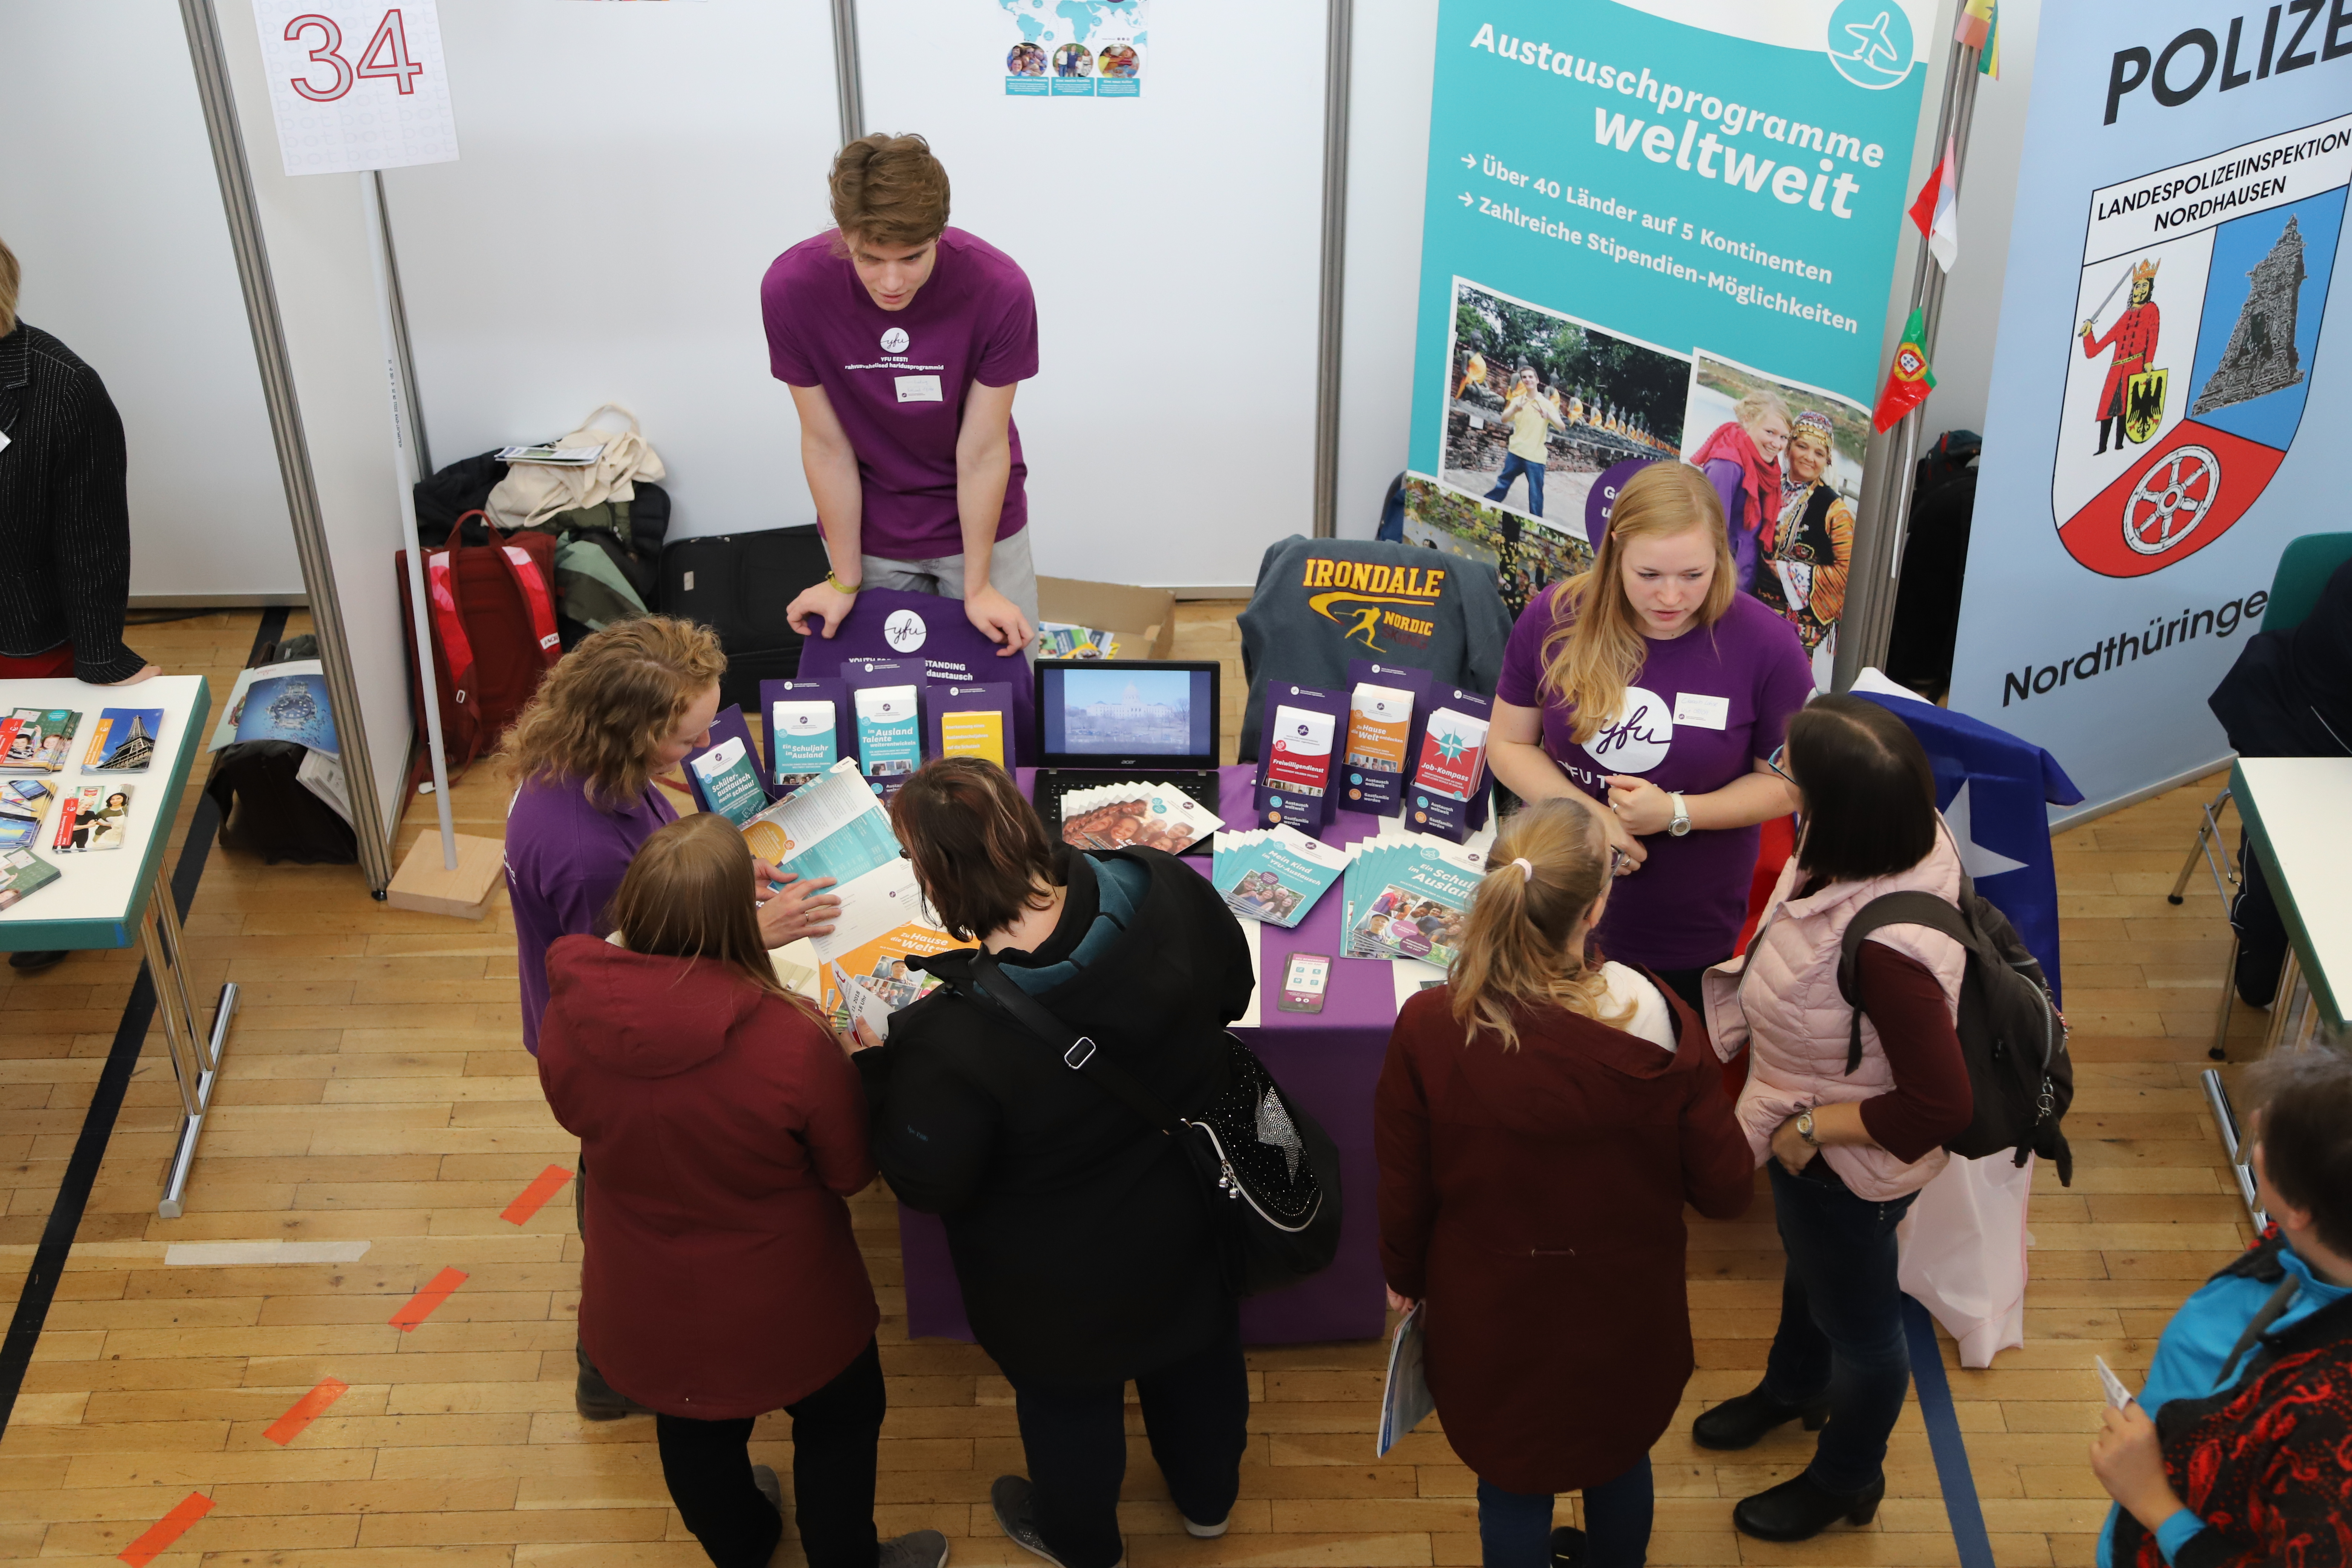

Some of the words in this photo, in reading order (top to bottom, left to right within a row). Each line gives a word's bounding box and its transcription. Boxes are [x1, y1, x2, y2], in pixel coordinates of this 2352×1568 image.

[284, 9, 423, 102] 34
[2104, 0, 2352, 126] POLIZE
[1470, 23, 1885, 168] Austauschprogramme
[1594, 106, 1860, 220] weltweit
[2098, 129, 2352, 221] LANDESPOLIZEIINSPEKTION
[2154, 176, 2286, 232] NORDHAUSEN
[1483, 153, 1528, 188] Über
[1534, 176, 1560, 198] 40
[1566, 187, 1637, 223] Länder
[1642, 213, 1677, 236] auf
[1681, 222, 1694, 241] 5
[1701, 227, 1833, 285] Kontinenten
[1478, 196, 1582, 246] Zahlreiche
[1586, 232, 1857, 334] Stipendien-Möglichkeiten
[889, 363, 944, 371] haridusprogrammid
[1303, 558, 1445, 597] IRONDALE
[885, 618, 926, 645] yfu
[1383, 611, 1434, 636] NORDIC
[1382, 626, 1429, 650] SKIING
[2003, 590, 2268, 707] Nordthüringe
[876, 727, 913, 736] Ausland
[1358, 730, 1380, 741] Welt
[1363, 724, 1386, 735] Hause
[1273, 759, 1324, 773] Freiwilligendienst
[1421, 762, 1469, 782] Job-Kompass
[712, 774, 738, 793] Schüler-
[717, 773, 751, 797] austausch
[718, 793, 732, 804] macht
[732, 779, 754, 797] schlau!
[1430, 806, 1449, 815] weltweit
[1431, 802, 1453, 812] Austausch
[1429, 817, 1453, 828] Gastfamilie
[1269, 850, 1289, 864] Mein
[1290, 862, 1312, 874] Kind
[1270, 859, 1321, 885] YFU-Austausch
[1420, 864, 1434, 872] Ein
[902, 939, 935, 952] Welt
[910, 933, 948, 946] Hause
